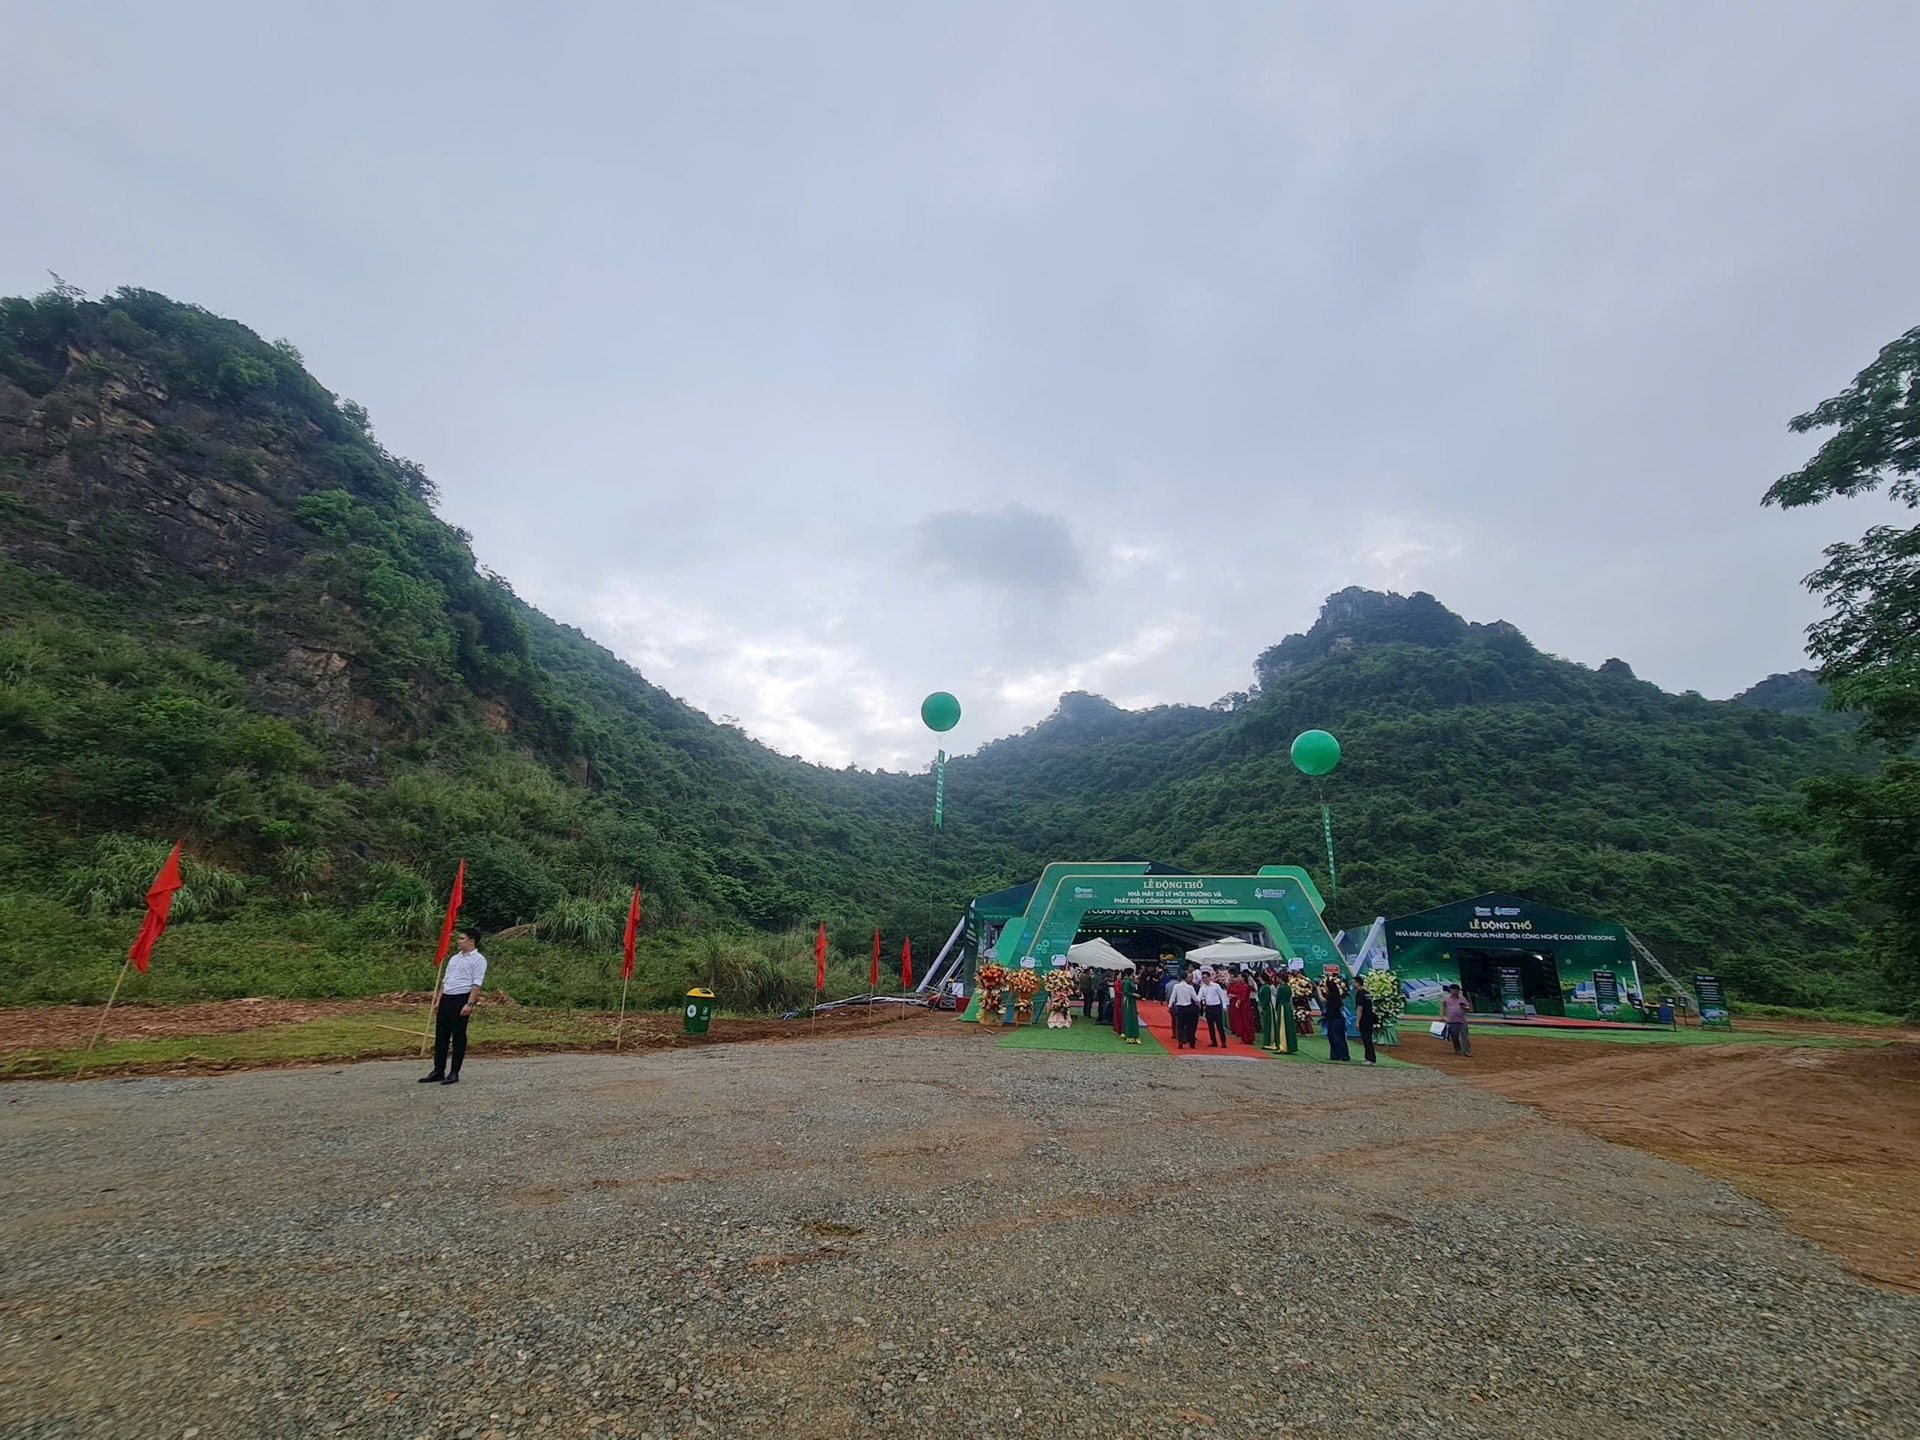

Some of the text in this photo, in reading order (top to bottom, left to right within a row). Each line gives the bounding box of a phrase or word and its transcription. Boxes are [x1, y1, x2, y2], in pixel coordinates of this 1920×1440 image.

[1143, 878, 1204, 890] LỄ ĐỘNG THỔ
[1165, 897, 1182, 905] NGHỆ
[1469, 918, 1532, 931] LỄ ĐỘNG THỔ
